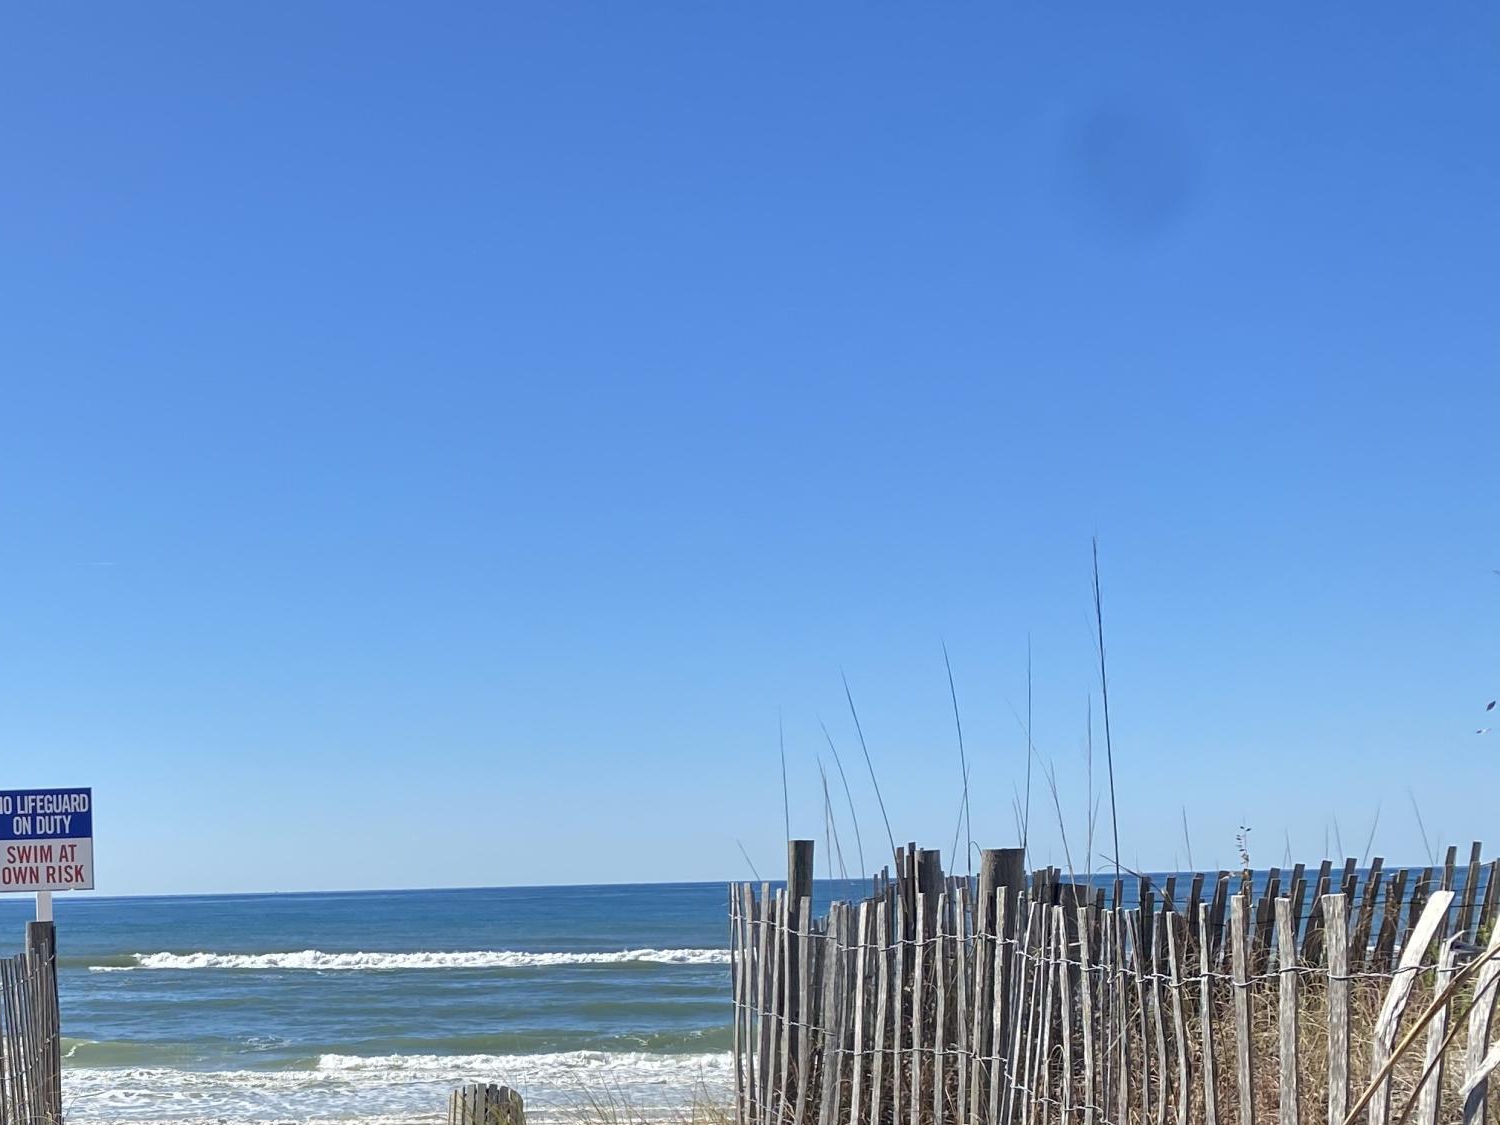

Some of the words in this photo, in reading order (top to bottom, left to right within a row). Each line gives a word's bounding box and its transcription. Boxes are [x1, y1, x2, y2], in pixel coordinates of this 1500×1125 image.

[16, 793, 89, 814] LIFEGUARD
[12, 816, 32, 835] ON
[36, 815, 72, 834] DUTY
[7, 845, 52, 864] SWIM
[59, 844, 77, 862] AT
[2, 866, 39, 885] OWN
[46, 864, 85, 883] RISK
